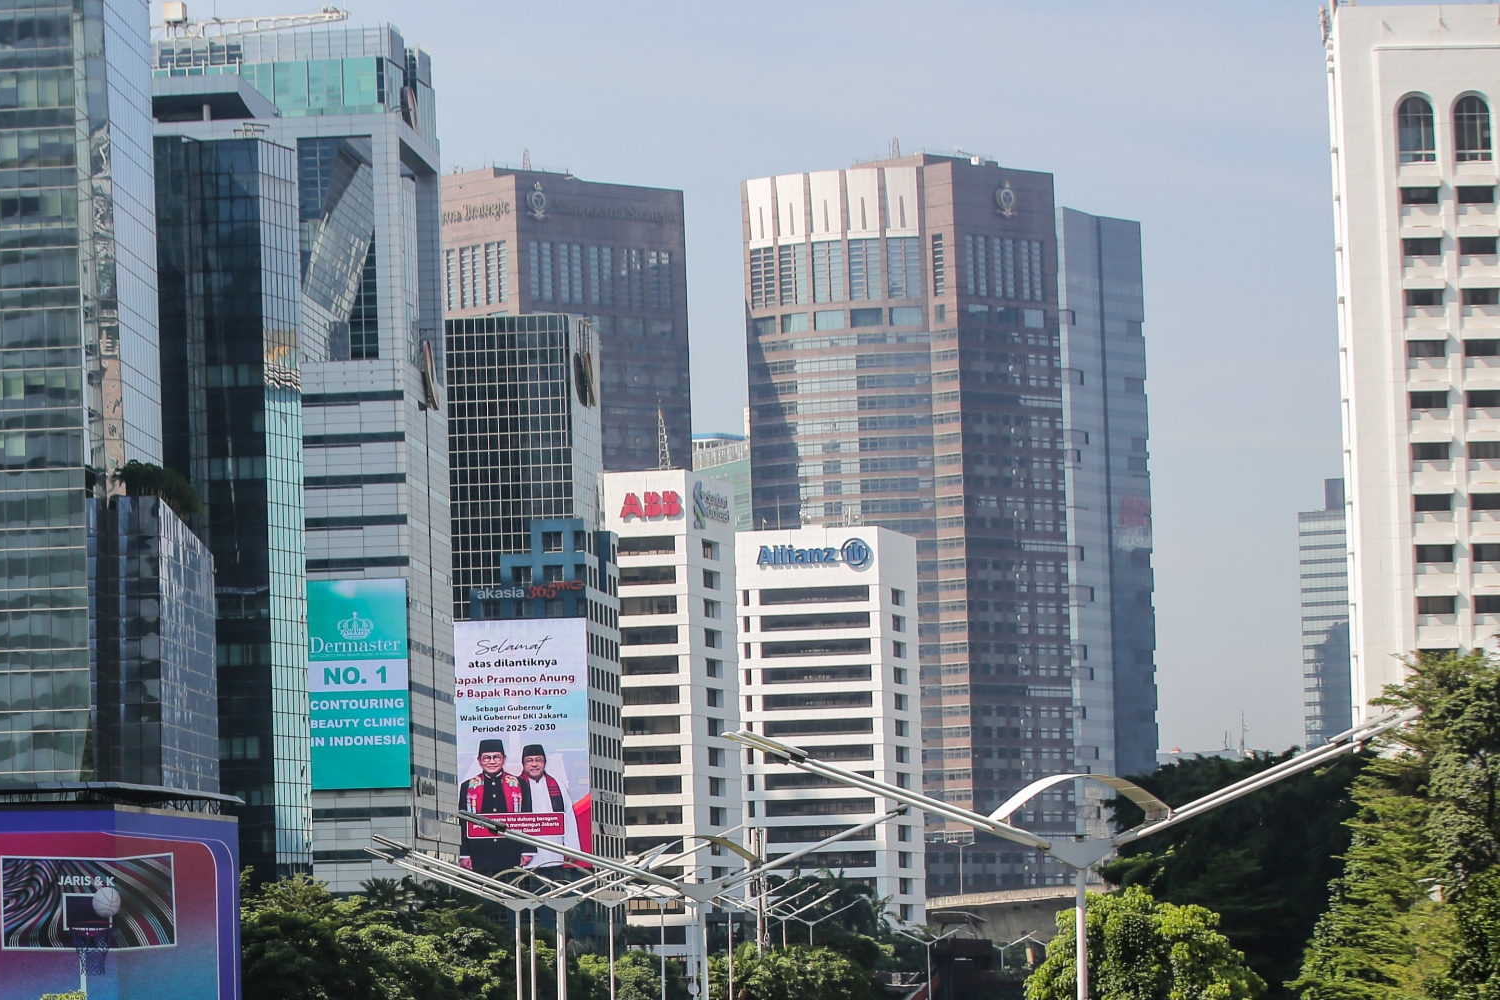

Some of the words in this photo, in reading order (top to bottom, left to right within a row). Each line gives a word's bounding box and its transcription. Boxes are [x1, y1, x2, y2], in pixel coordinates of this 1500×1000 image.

[619, 490, 682, 519] ABB
[757, 543, 837, 565] Allianz
[476, 587, 525, 599] akasia
[308, 636, 401, 654] Dermaster
[474, 635, 553, 656] Selamat
[468, 659, 492, 669] atas
[493, 658, 558, 669] dilantiknya
[323, 666, 367, 685] NO.
[375, 665, 387, 684] 1
[486, 674, 537, 685] Pramono
[539, 673, 575, 684] Anung
[456, 690, 464, 698] &
[467, 688, 501, 699] Bapak
[503, 688, 532, 697] Rano
[534, 686, 567, 696] Karno
[309, 698, 405, 711] CONTOURING
[475, 704, 506, 713] Sebagai
[507, 704, 545, 712] Gubernur
[310, 718, 360, 729] BEAUTY
[363, 717, 405, 727] CLINIC
[460, 714, 482, 722] Wakil
[483, 713, 521, 721] Gubernur
[538, 712, 568, 720] Jakarta
[472, 724, 505, 733] Periode
[506, 724, 527, 732] 2025
[534, 723, 556, 731] 2030
[310, 736, 325, 747] IN
[329, 734, 407, 747] INDONESIA
[57, 875, 92, 886] JARIS
[94, 876, 104, 887] &
[106, 876, 116, 887] K
